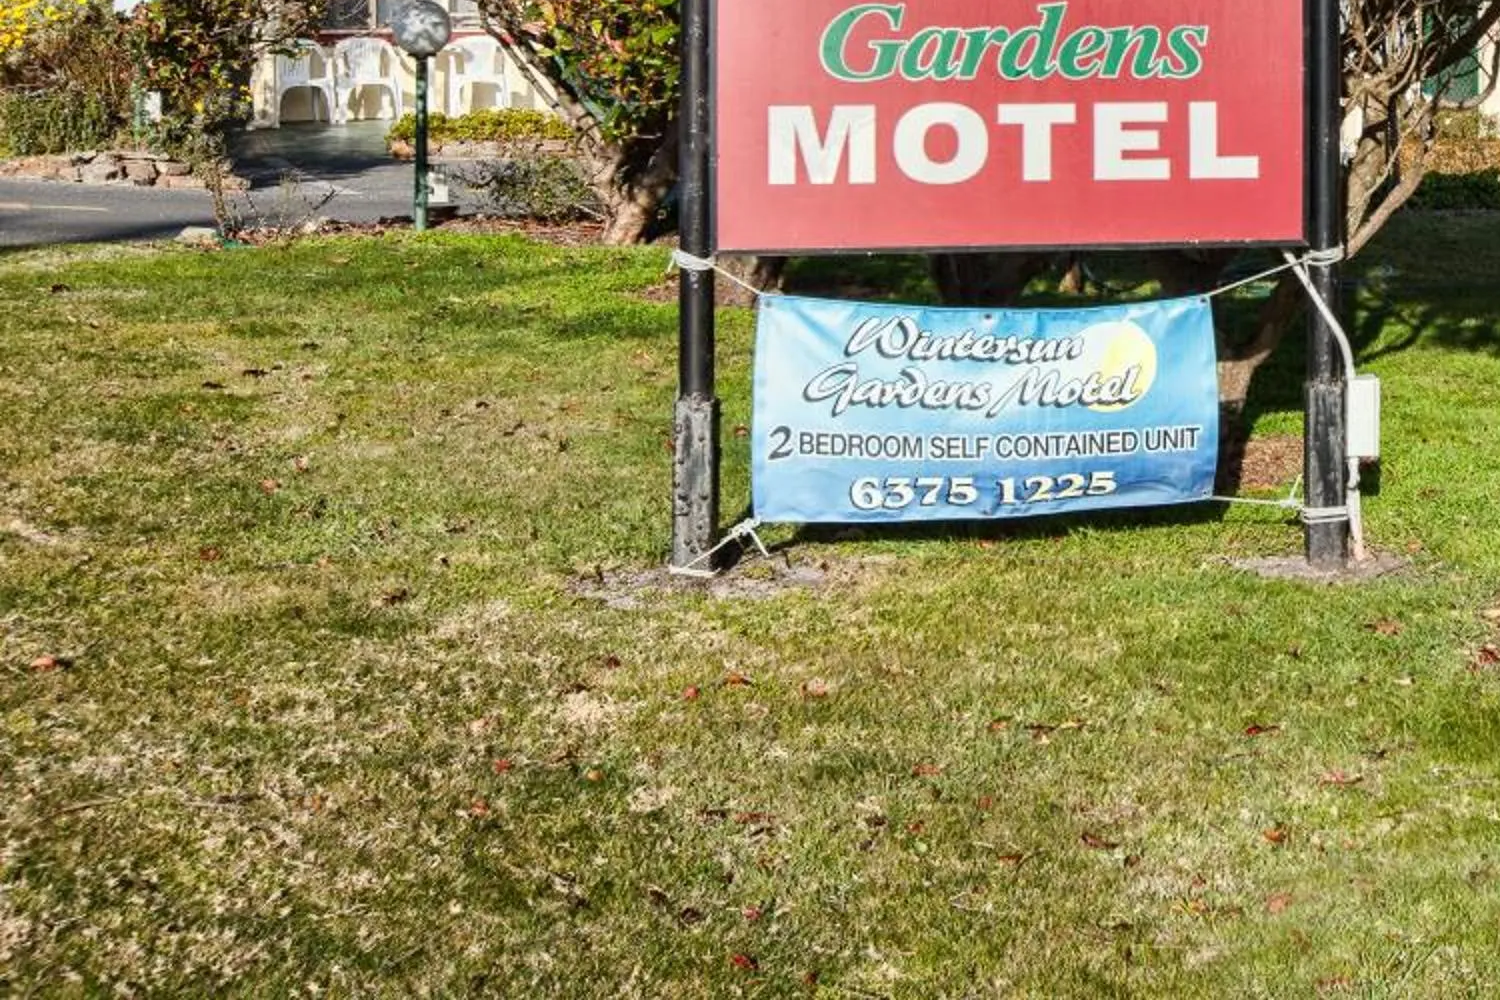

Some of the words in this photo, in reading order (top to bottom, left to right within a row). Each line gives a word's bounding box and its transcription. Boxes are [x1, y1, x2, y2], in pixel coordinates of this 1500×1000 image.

[819, 2, 1208, 82] Gardens
[767, 101, 1260, 186] MOTEL
[844, 315, 1085, 364] Wintersun
[802, 363, 991, 417] Gardens
[986, 364, 1143, 418] Motel
[768, 425, 793, 461] 2
[799, 432, 923, 460] BEDROOM
[929, 435, 989, 460] SELF
[995, 431, 1139, 459] CONTAINED
[1145, 426, 1200, 453] UNIT
[850, 475, 978, 510] 6375
[997, 470, 1118, 506] 1225
